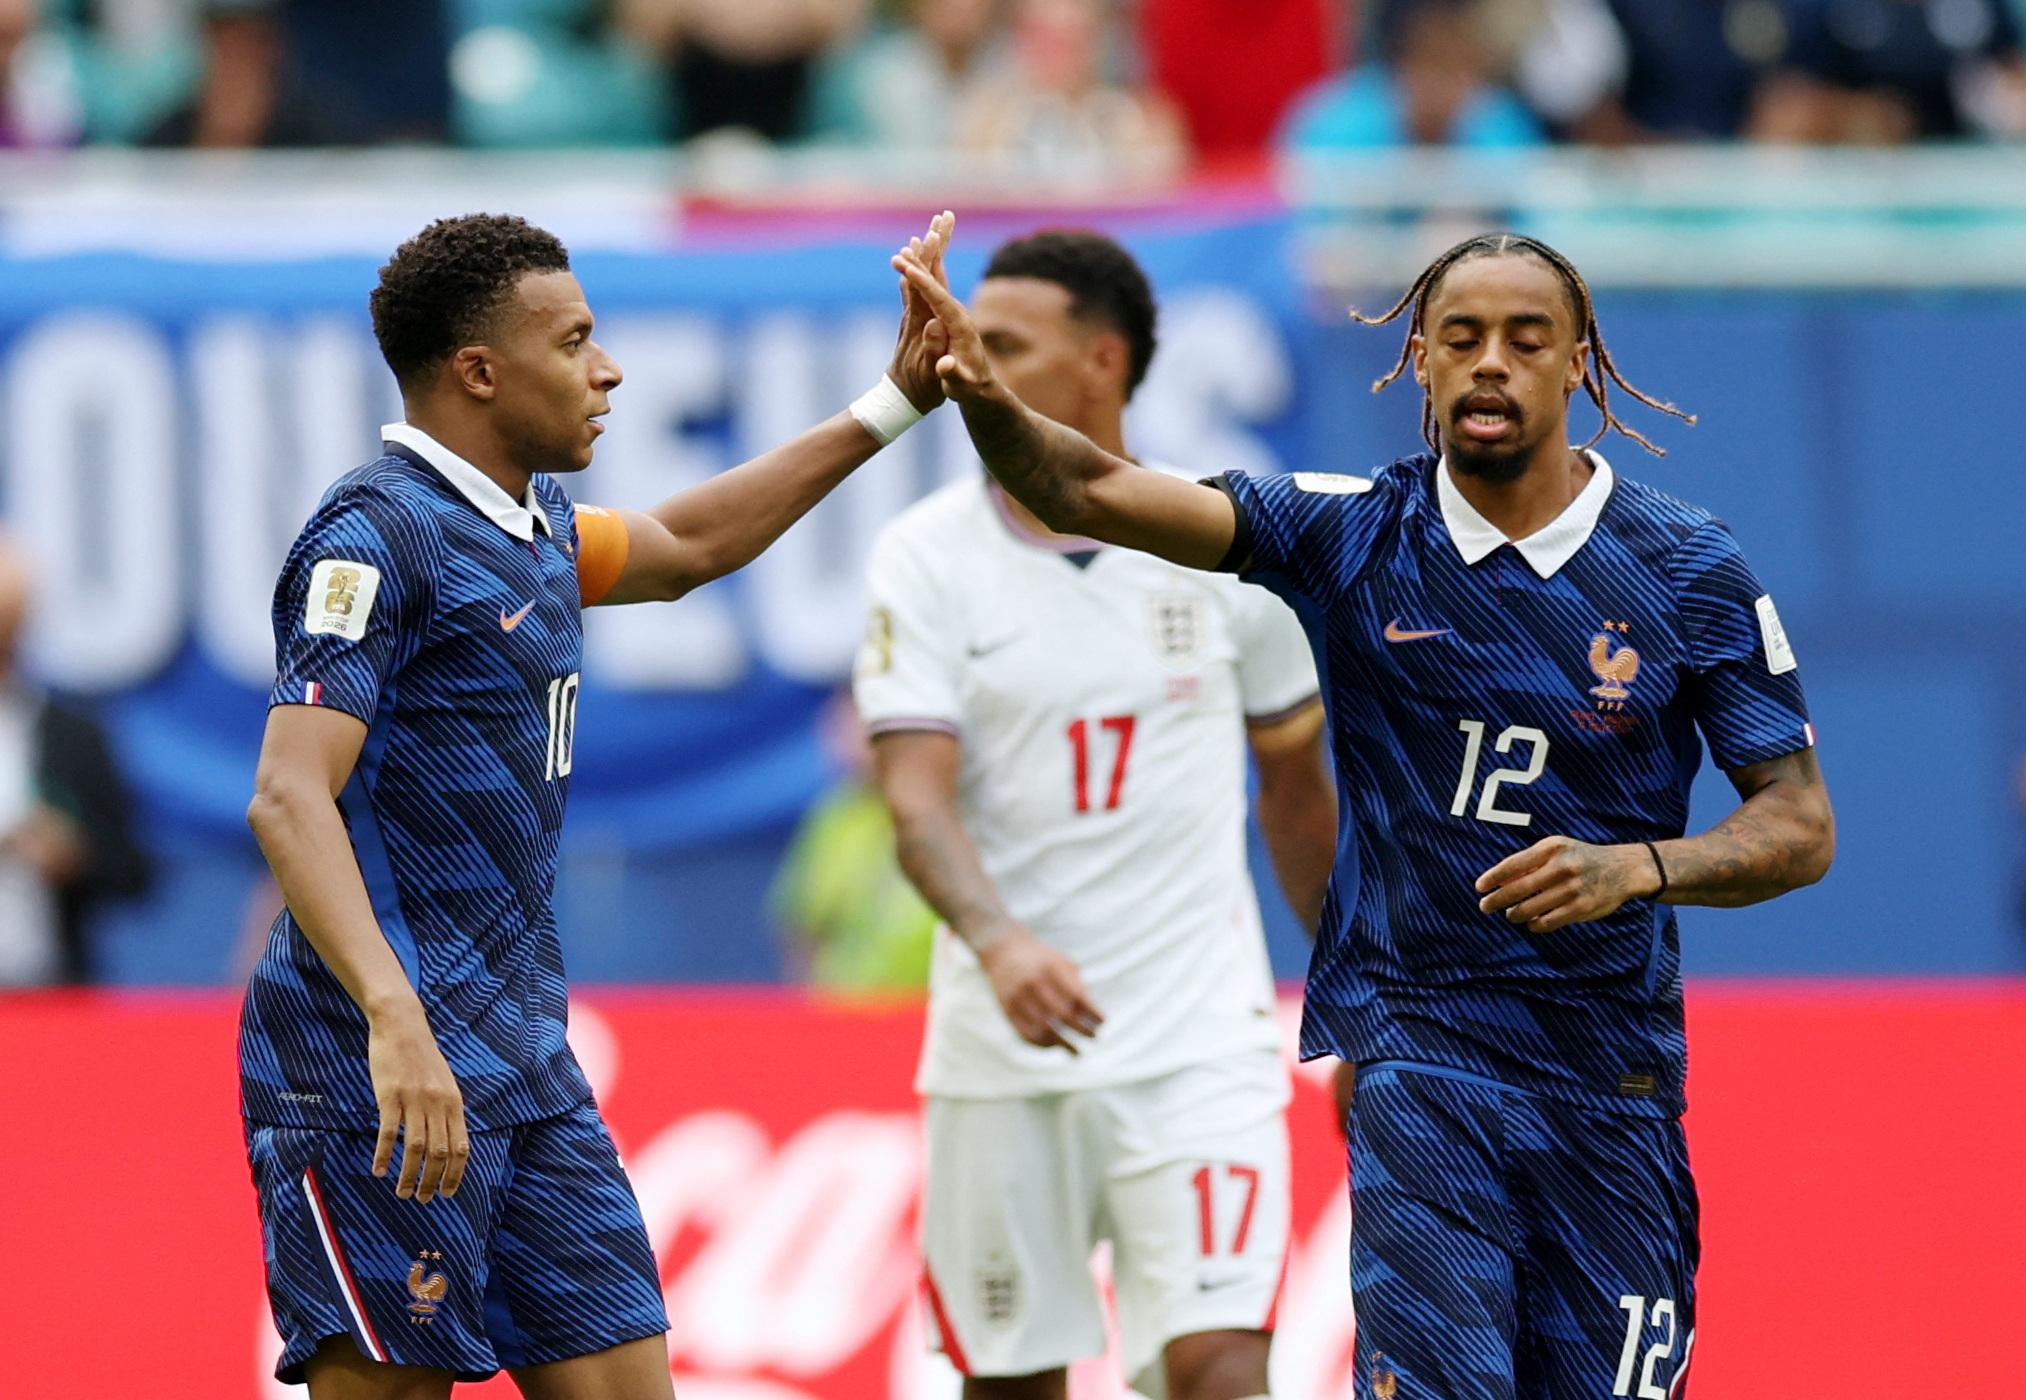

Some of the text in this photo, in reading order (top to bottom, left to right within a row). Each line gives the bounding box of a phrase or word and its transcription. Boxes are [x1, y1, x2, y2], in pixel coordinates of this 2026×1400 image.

[8, 286, 1294, 692] OUEUS
[321, 620, 348, 632] 2026
[546, 672, 579, 782] 10
[1066, 714, 1136, 814] 17
[1450, 719, 1550, 827] 12
[1192, 1166, 1258, 1255] 17
[1612, 1295, 1676, 1400] 12
